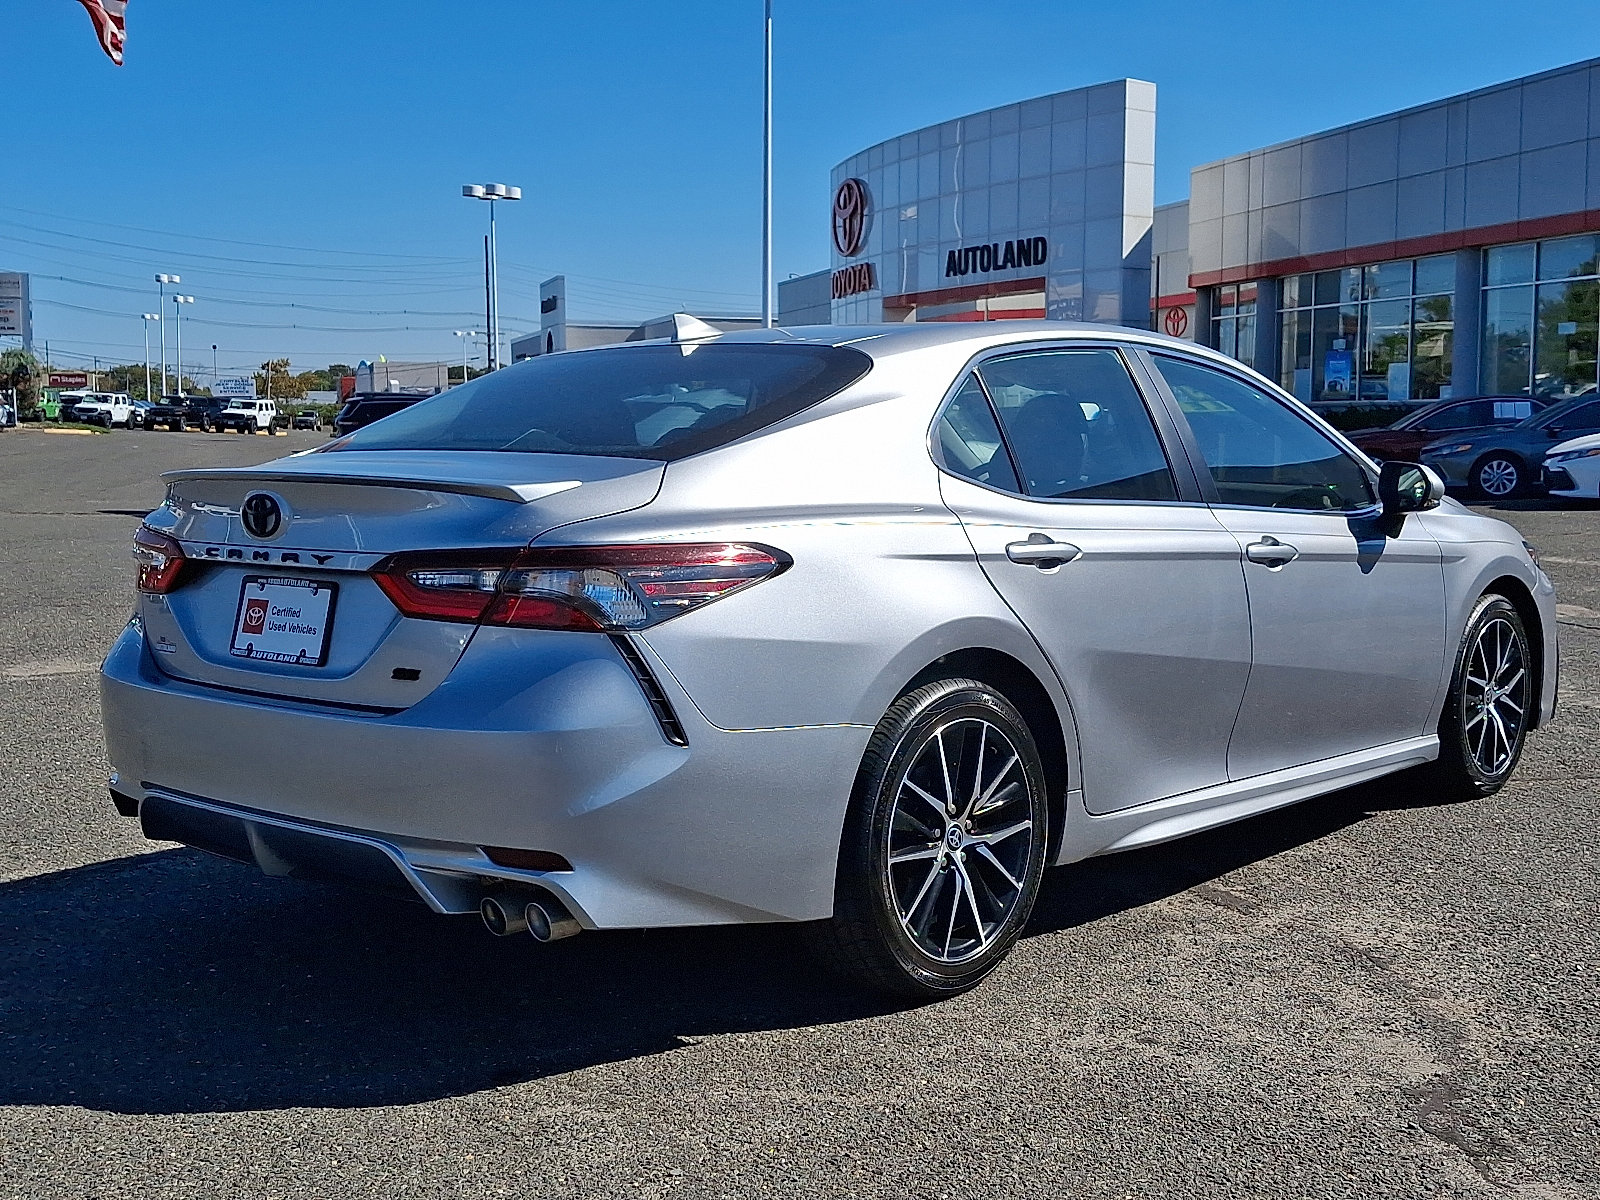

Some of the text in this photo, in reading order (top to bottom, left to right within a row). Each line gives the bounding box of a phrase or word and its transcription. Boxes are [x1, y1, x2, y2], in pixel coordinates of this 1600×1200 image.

[945, 236, 1048, 278] AUTOLAND
[61, 375, 86, 384] Staples
[205, 547, 335, 565] CAMRY
[271, 605, 302, 618] Certified
[268, 620, 317, 636] Used Vehicles
[250, 651, 297, 663] AUTOLAND
